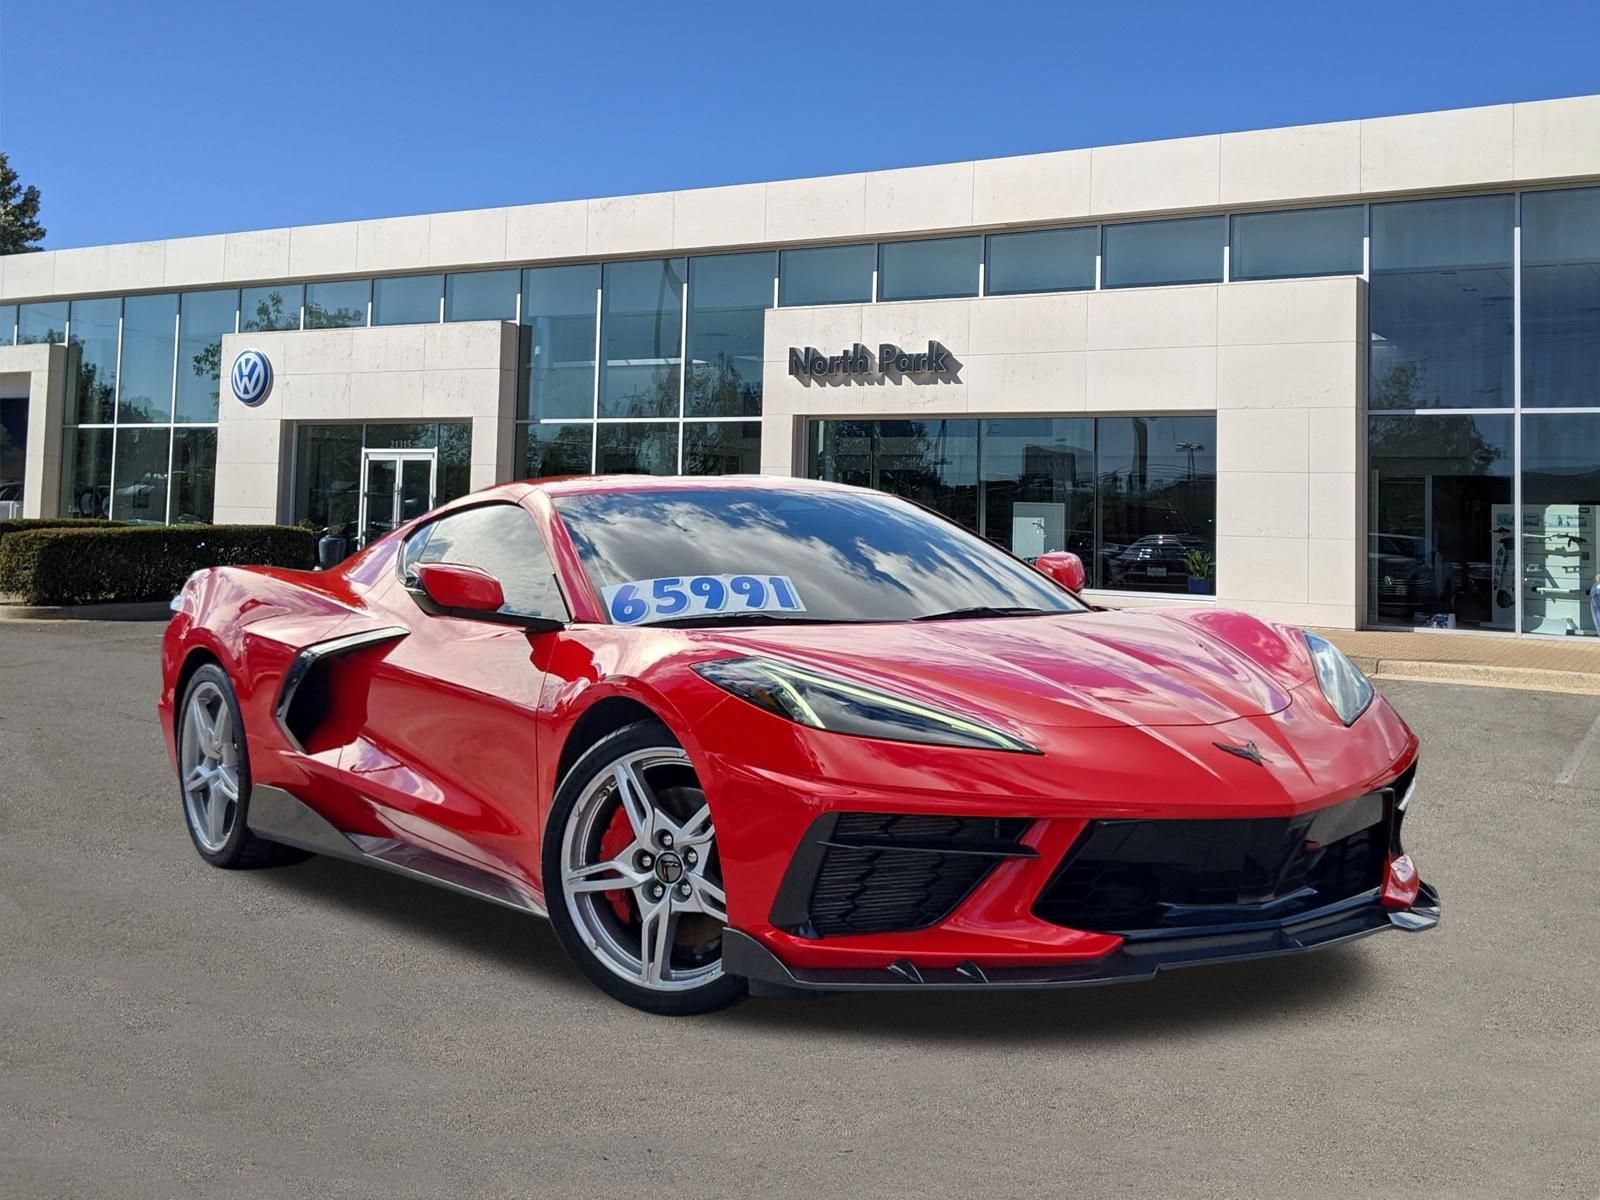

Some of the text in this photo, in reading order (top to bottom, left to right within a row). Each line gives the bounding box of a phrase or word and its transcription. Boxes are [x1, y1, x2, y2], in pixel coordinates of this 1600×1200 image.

[788, 340, 946, 376] North Park
[611, 576, 798, 623] 65991
